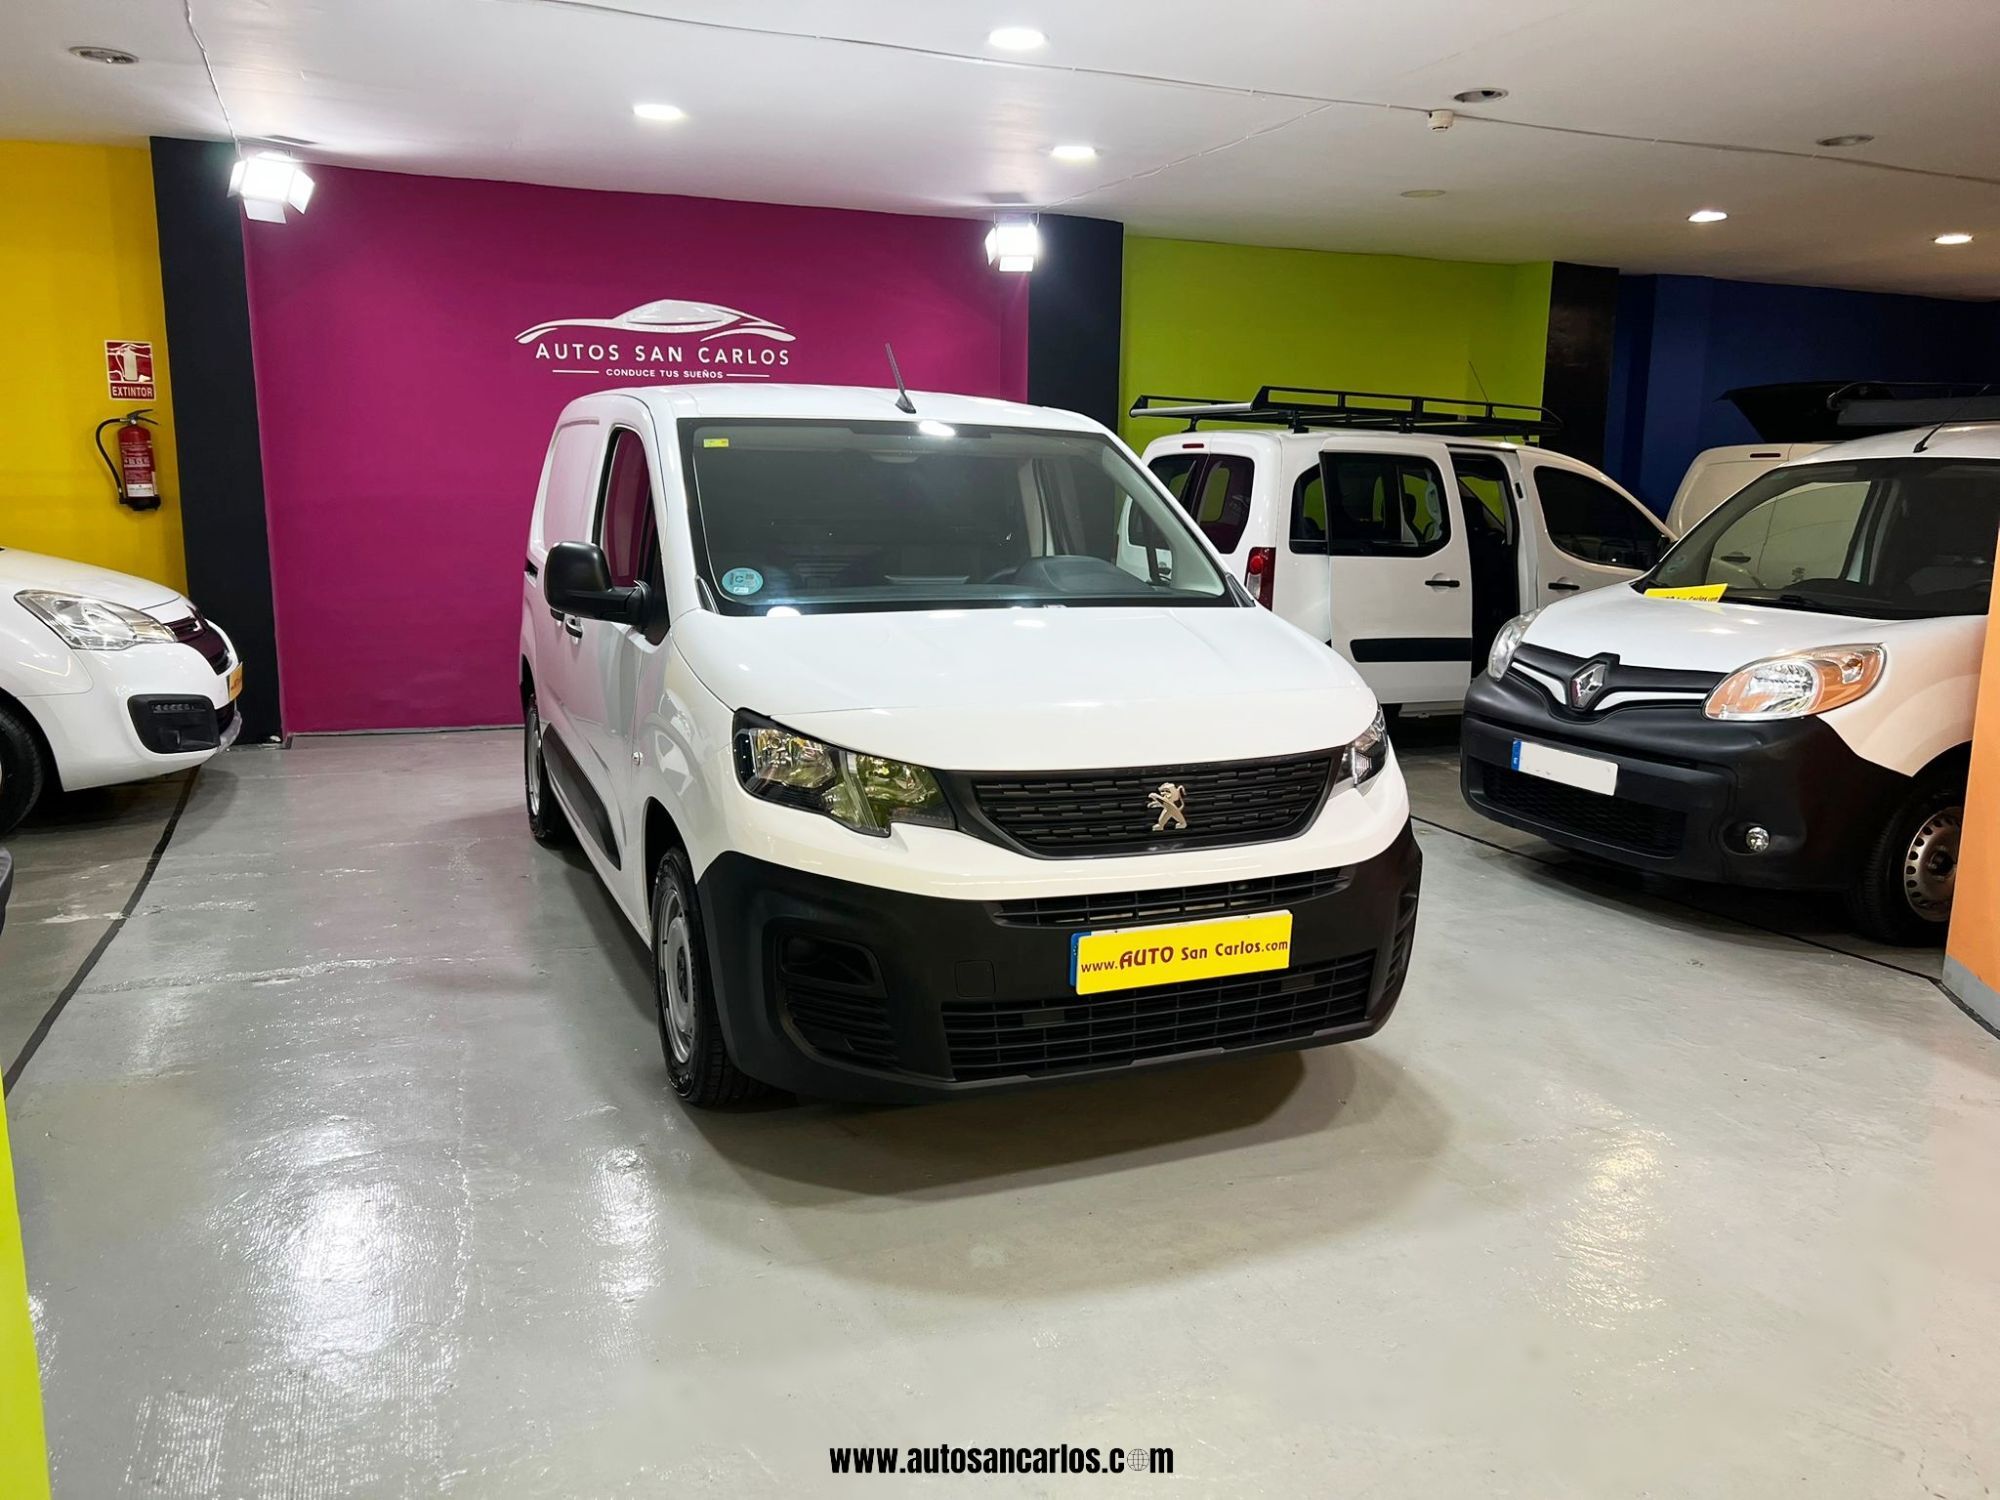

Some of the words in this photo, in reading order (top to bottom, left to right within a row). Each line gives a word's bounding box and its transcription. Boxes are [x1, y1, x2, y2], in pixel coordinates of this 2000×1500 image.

[535, 342, 620, 361] AUTOS
[635, 345, 683, 363] SAN
[698, 347, 790, 365] CARLOS
[606, 368, 655, 377] CONDUCE
[660, 370, 679, 378] TUS
[683, 369, 723, 379] SUEÑOS
[112, 386, 153, 397] EXTINTOR
[1181, 947, 1208, 961] San
[1215, 940, 1289, 957] Carlos.com
